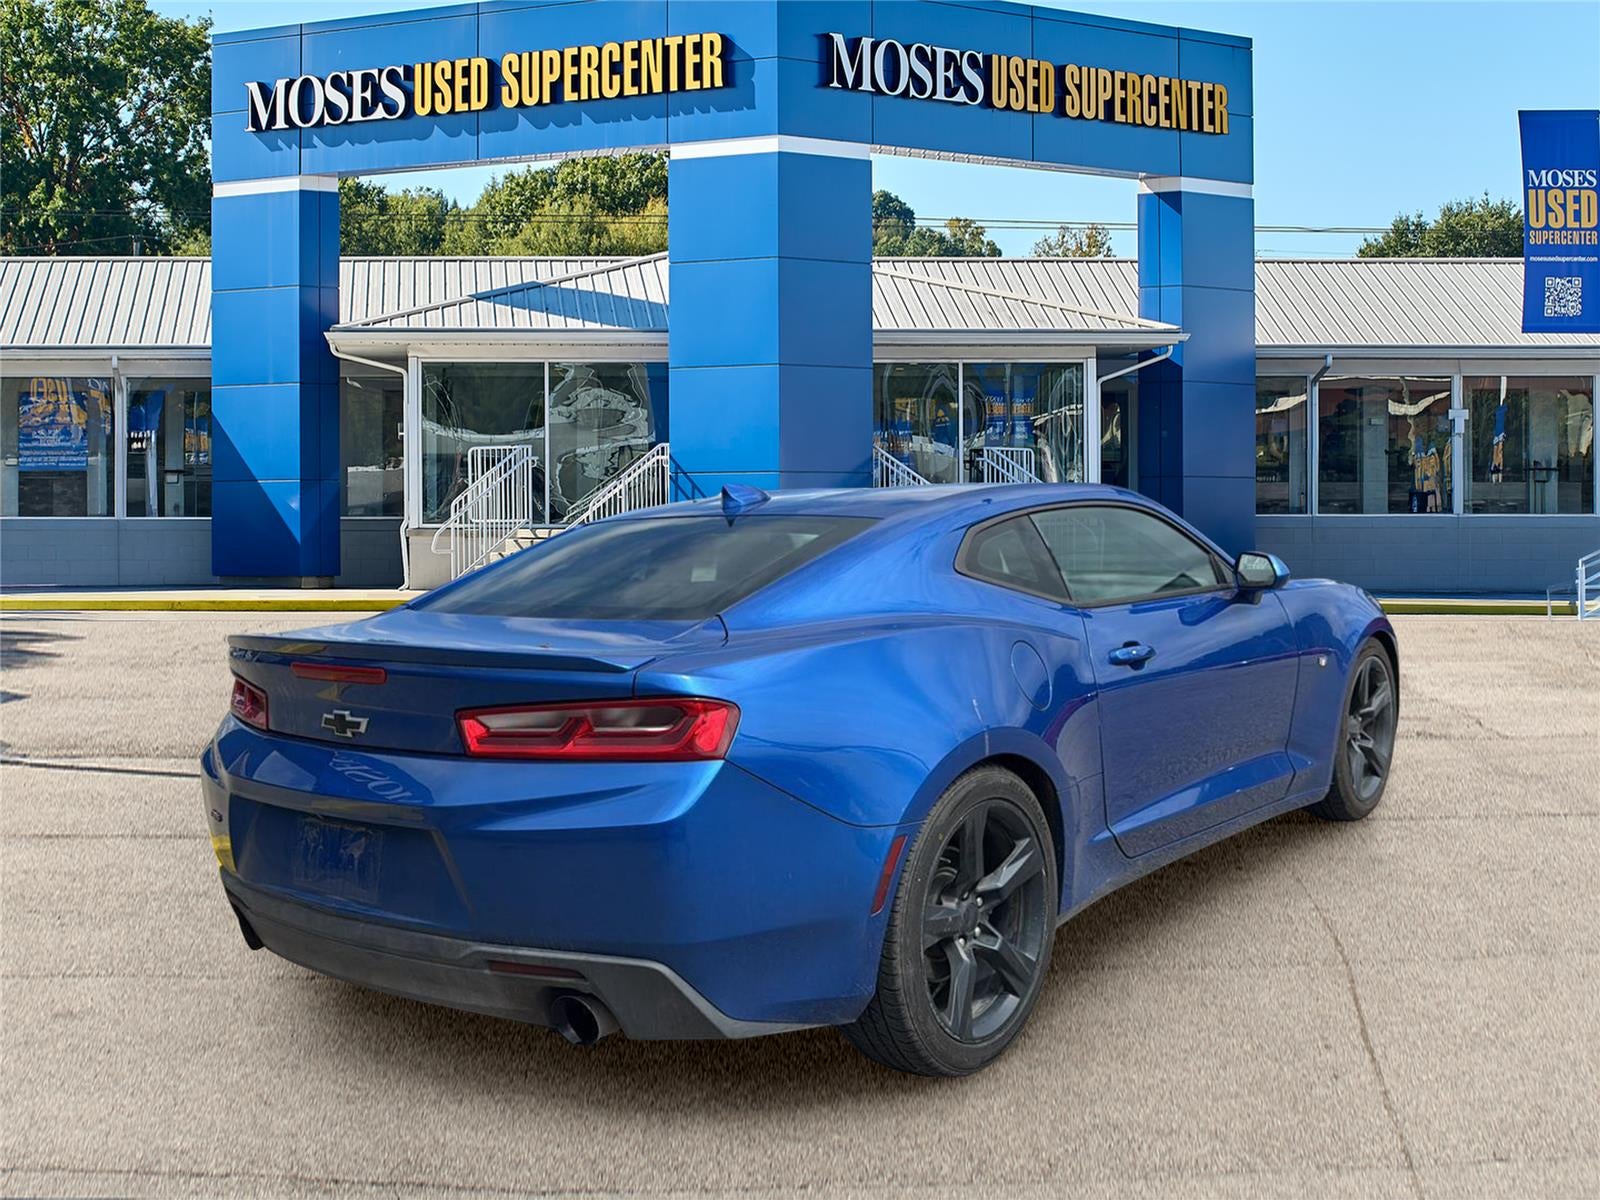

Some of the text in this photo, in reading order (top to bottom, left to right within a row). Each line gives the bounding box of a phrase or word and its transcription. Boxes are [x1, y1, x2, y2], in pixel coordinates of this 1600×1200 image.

[244, 31, 725, 132] MOSES USED SUPERCENTER
[829, 31, 1230, 135] MOSES USED SUPERCENTER
[1528, 169, 1597, 187] MOSES
[1528, 189, 1598, 228] USED
[1529, 229, 1598, 246] SUPERCENTER
[1529, 255, 1598, 263] mosesusedsupercenter.com
